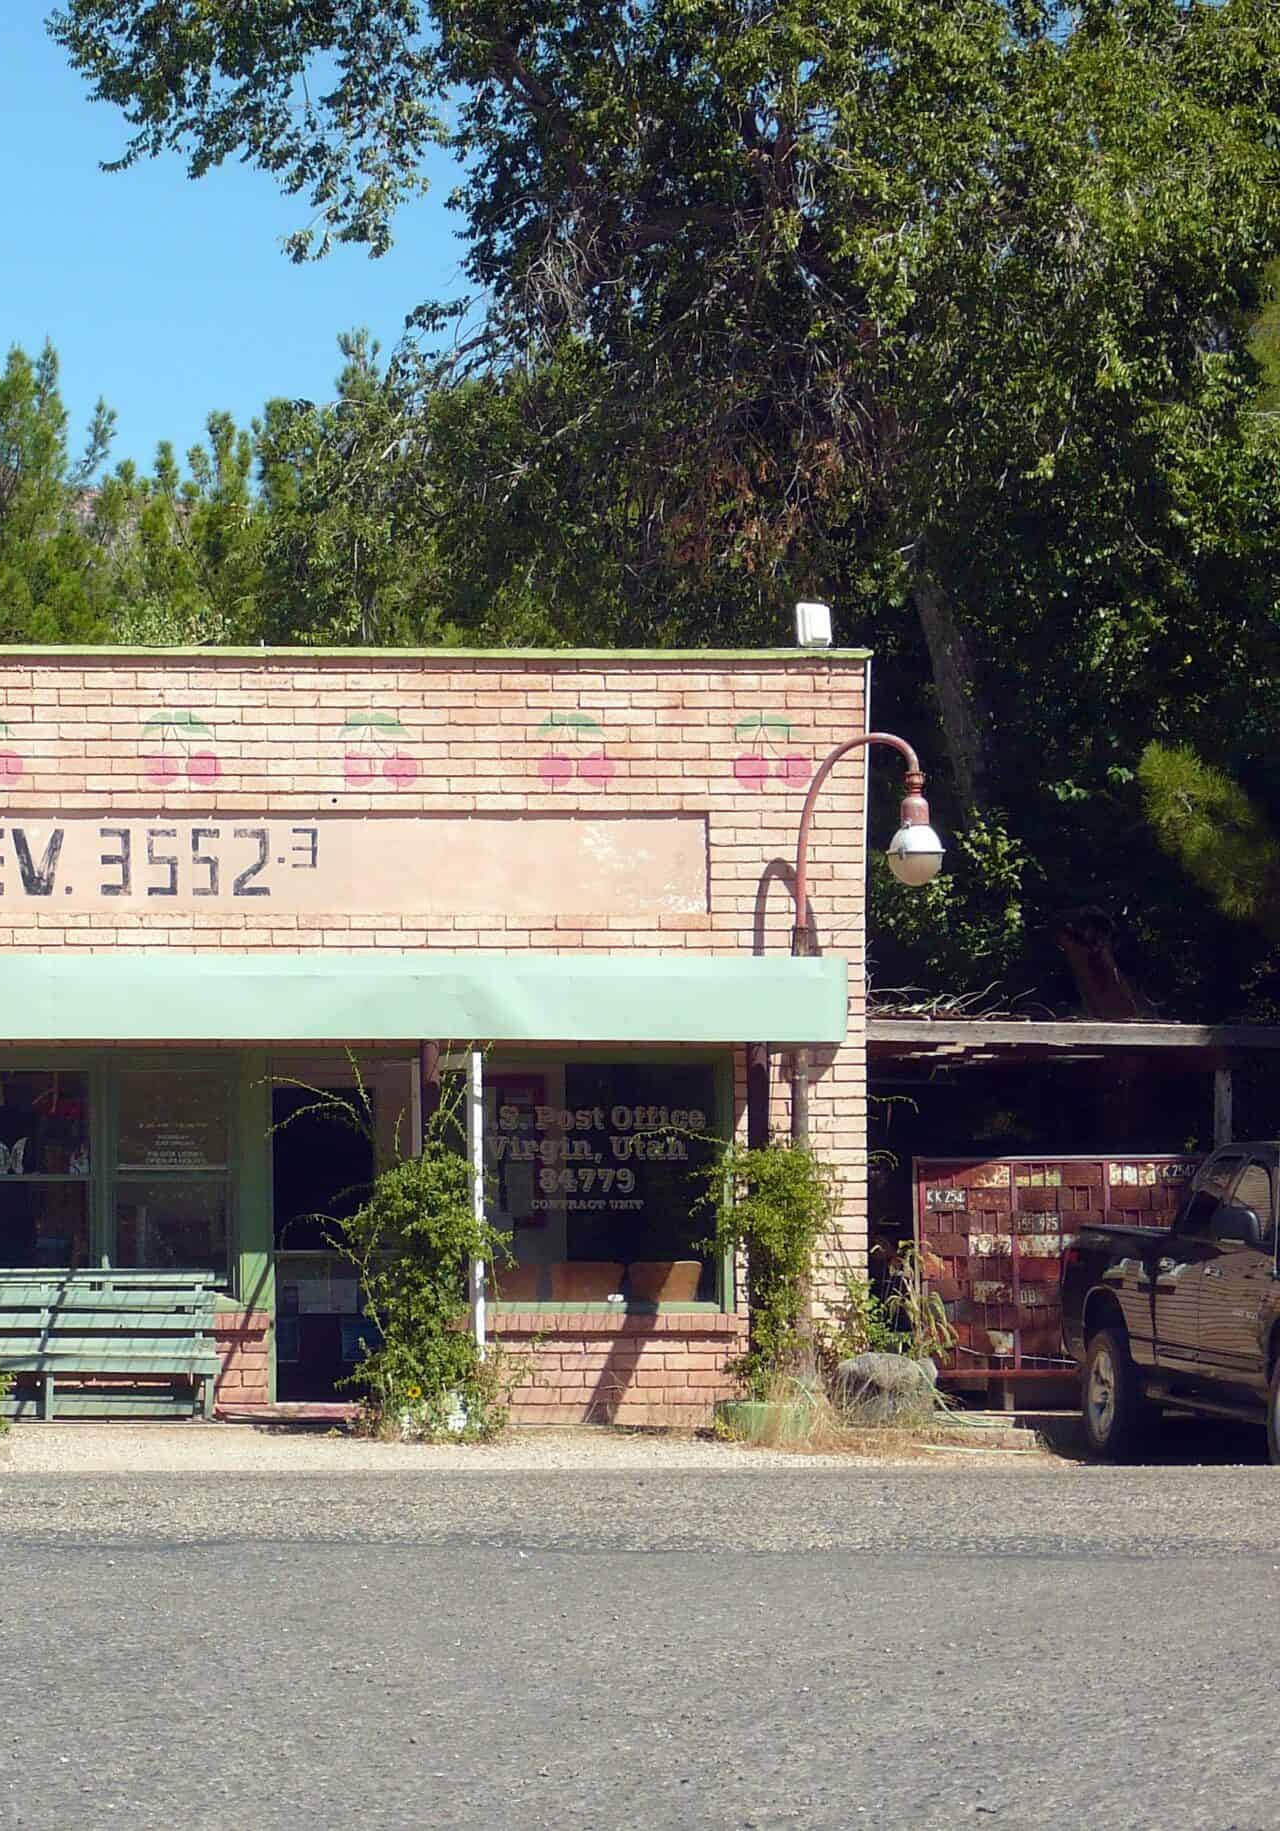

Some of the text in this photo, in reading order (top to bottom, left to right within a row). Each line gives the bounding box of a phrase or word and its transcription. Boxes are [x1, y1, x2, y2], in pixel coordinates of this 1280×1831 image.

[534, 1105, 605, 1131] Post
[611, 1105, 706, 1131] Office
[486, 1135, 689, 1164] Virgin, Utah
[539, 1168, 636, 1193] 84779
